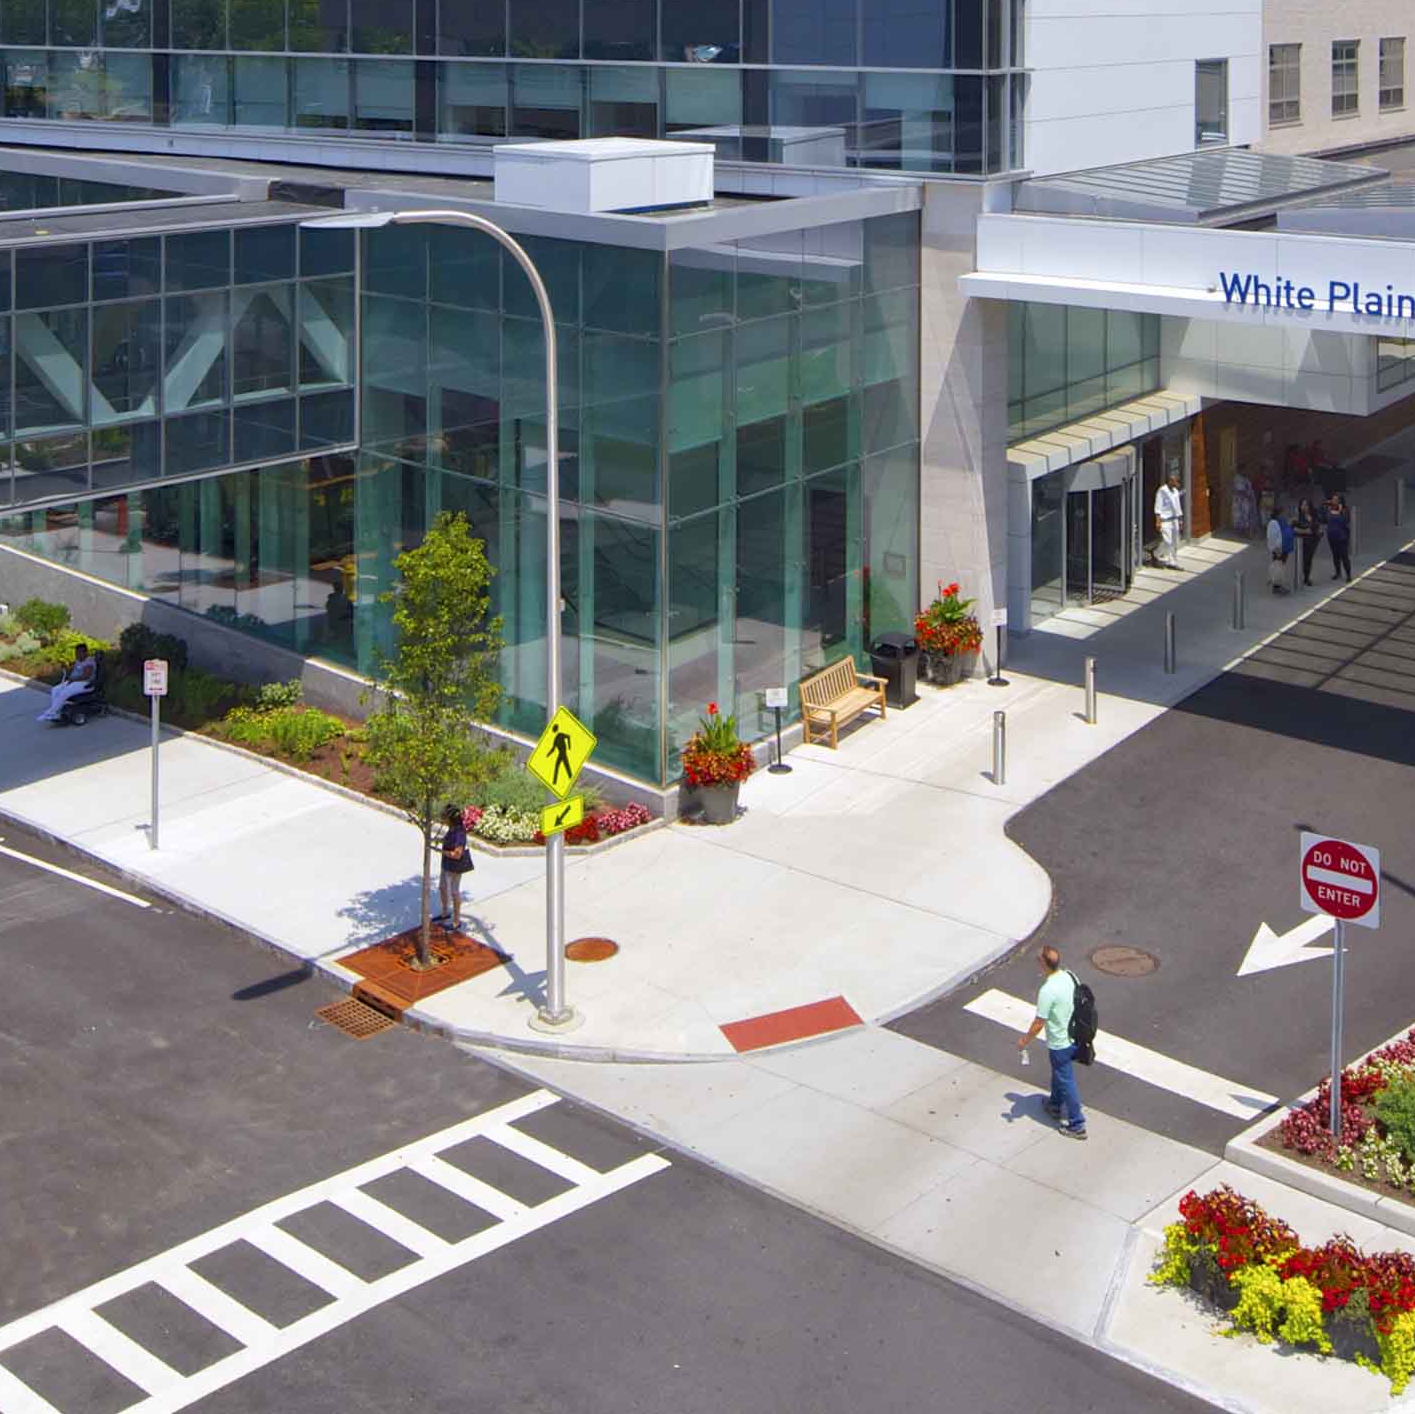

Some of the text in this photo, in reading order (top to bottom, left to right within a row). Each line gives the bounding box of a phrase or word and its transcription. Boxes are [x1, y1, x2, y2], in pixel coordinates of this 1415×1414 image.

[1220, 271, 1315, 310] White
[1313, 851, 1366, 875] DO NOT
[1318, 886, 1361, 908] ENTER
